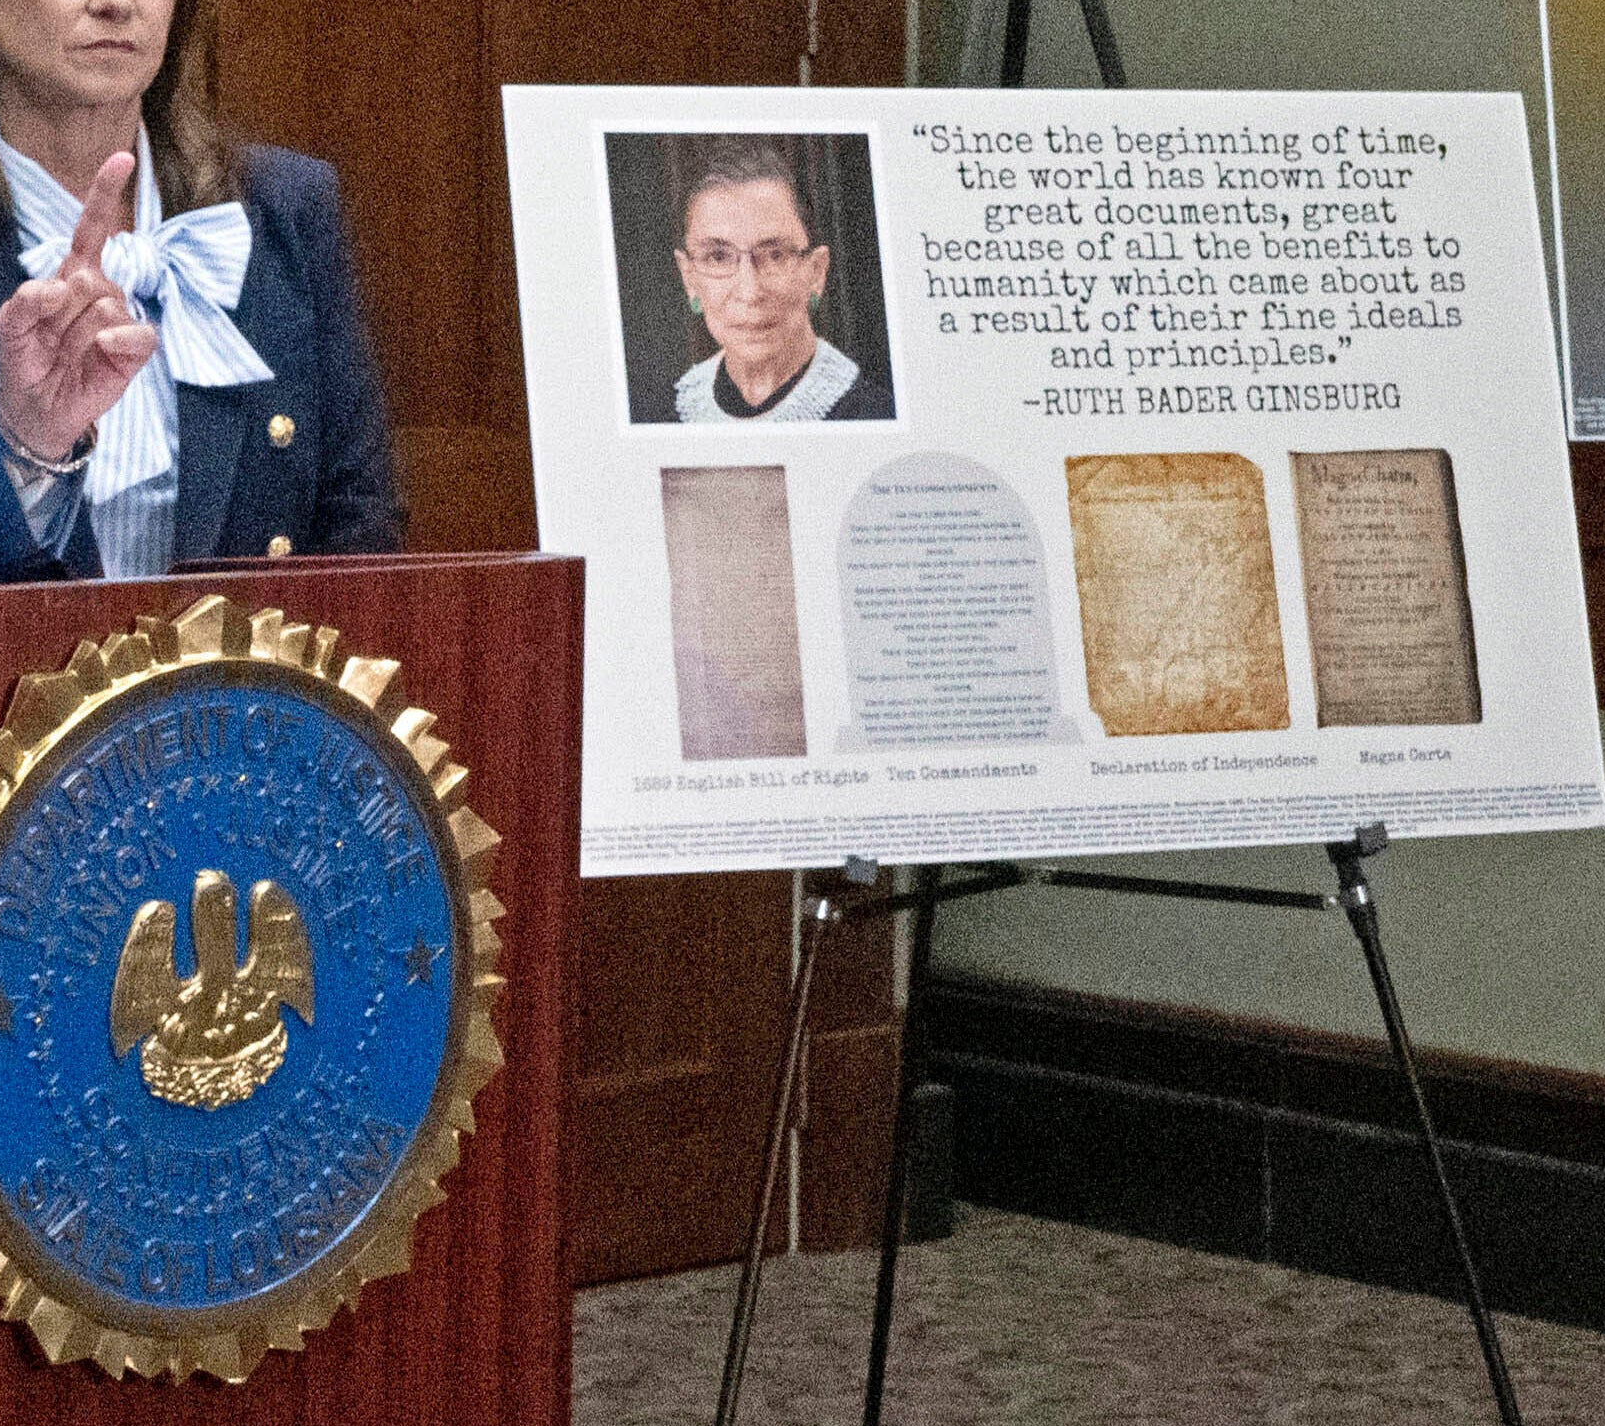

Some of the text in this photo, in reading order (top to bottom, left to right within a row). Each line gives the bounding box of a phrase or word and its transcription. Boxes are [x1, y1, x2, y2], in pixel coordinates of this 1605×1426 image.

[912, 124, 1447, 161] “Since the beginning of time,
[956, 158, 1413, 190] the world has known four
[984, 195, 1397, 229] great documents, great
[920, 229, 1460, 261] because of all the benefits to
[925, 265, 1466, 303] humanity which came about as
[939, 299, 1462, 333] a result of their fine ideals
[1050, 334, 1352, 372] and principles.”
[1136, 385, 1237, 414] BADER
[1245, 382, 1400, 412] GINSBURG
[886, 762, 1038, 781] Ten Commandments
[1090, 753, 1318, 775] Declaration of Independence
[1359, 747, 1451, 766] Magna Carta
[634, 768, 870, 792] 1689 English Bill of Rights
